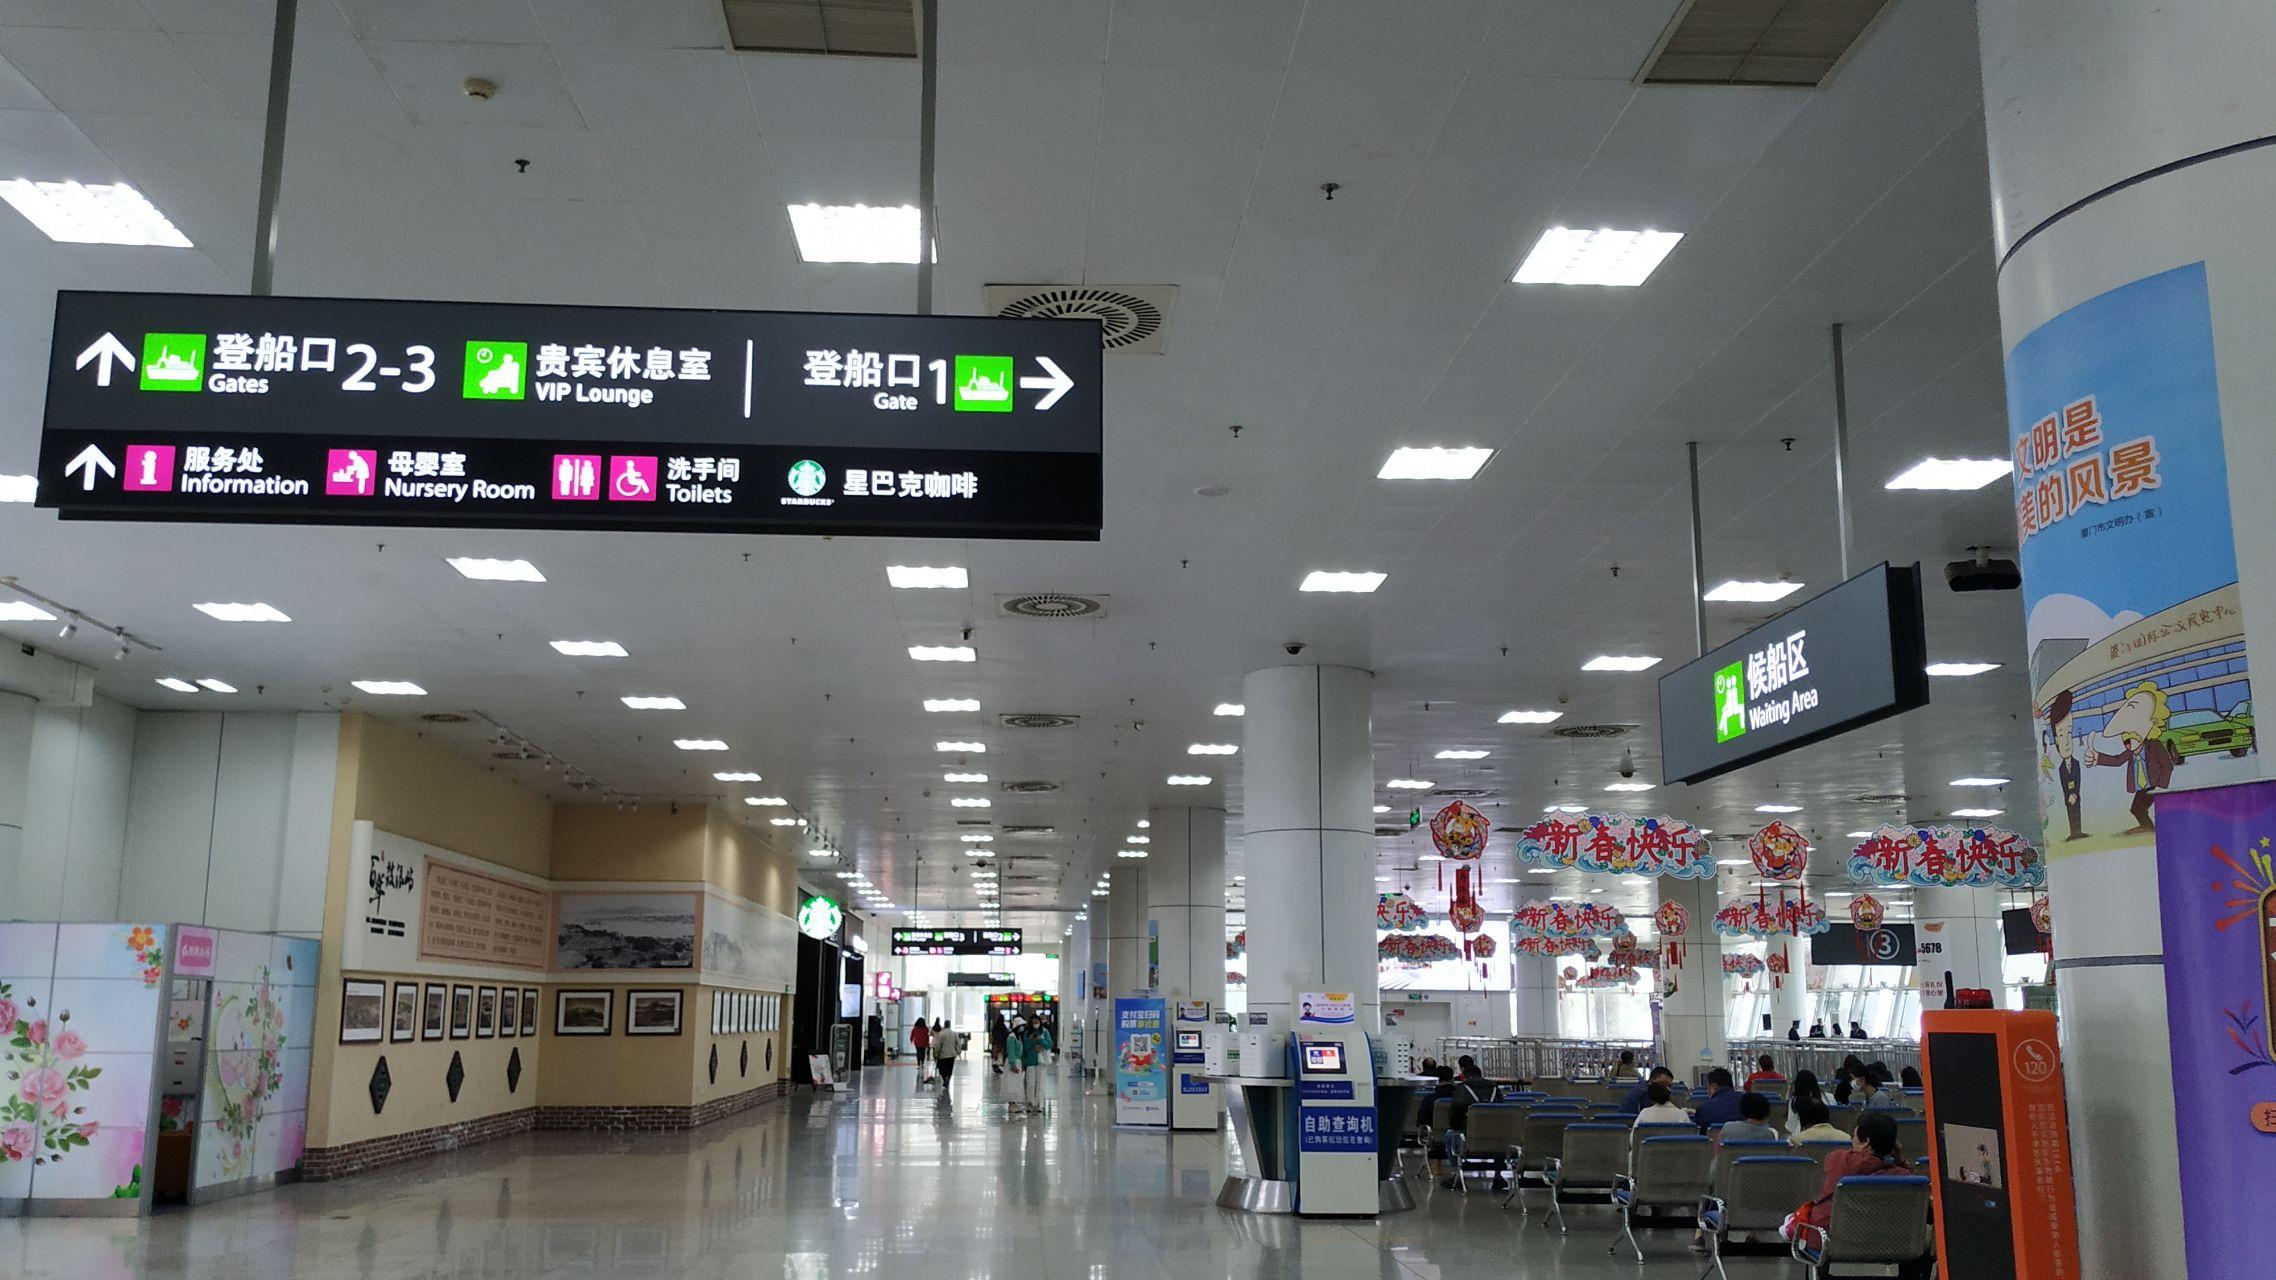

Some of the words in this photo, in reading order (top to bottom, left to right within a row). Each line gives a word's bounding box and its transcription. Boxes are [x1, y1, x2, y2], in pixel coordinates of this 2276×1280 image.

[213, 333, 337, 373] 登船口
[341, 343, 436, 393] 2-3
[536, 343, 712, 383] 贵宾休息室
[208, 374, 269, 394] Gates
[803, 349, 919, 388] 登船口
[928, 359, 947, 405] 1
[535, 382, 571, 401] VIP
[576, 383, 653, 408] Lounge
[873, 393, 918, 411] Gate
[183, 446, 264, 473] 服务处
[387, 451, 467, 477] 母婴室
[667, 457, 740, 483] 洗手间
[181, 474, 309, 496] Information
[384, 478, 469, 503] Nursery
[473, 480, 535, 500] Room
[666, 483, 733, 504] Toilets
[843, 468, 979, 500] 星巴克咖啡
[1747, 630, 1810, 700] 候船区
[1749, 700, 1791, 731] Waiting
[1790, 688, 1819, 716] Area
[1544, 819, 1700, 867] 新春快乐
[1875, 835, 2030, 877] 新春快乐
[1880, 934, 1893, 951] 3
[2024, 1061, 2047, 1076] 120
[1305, 1115, 1374, 1134] 自助查询机
